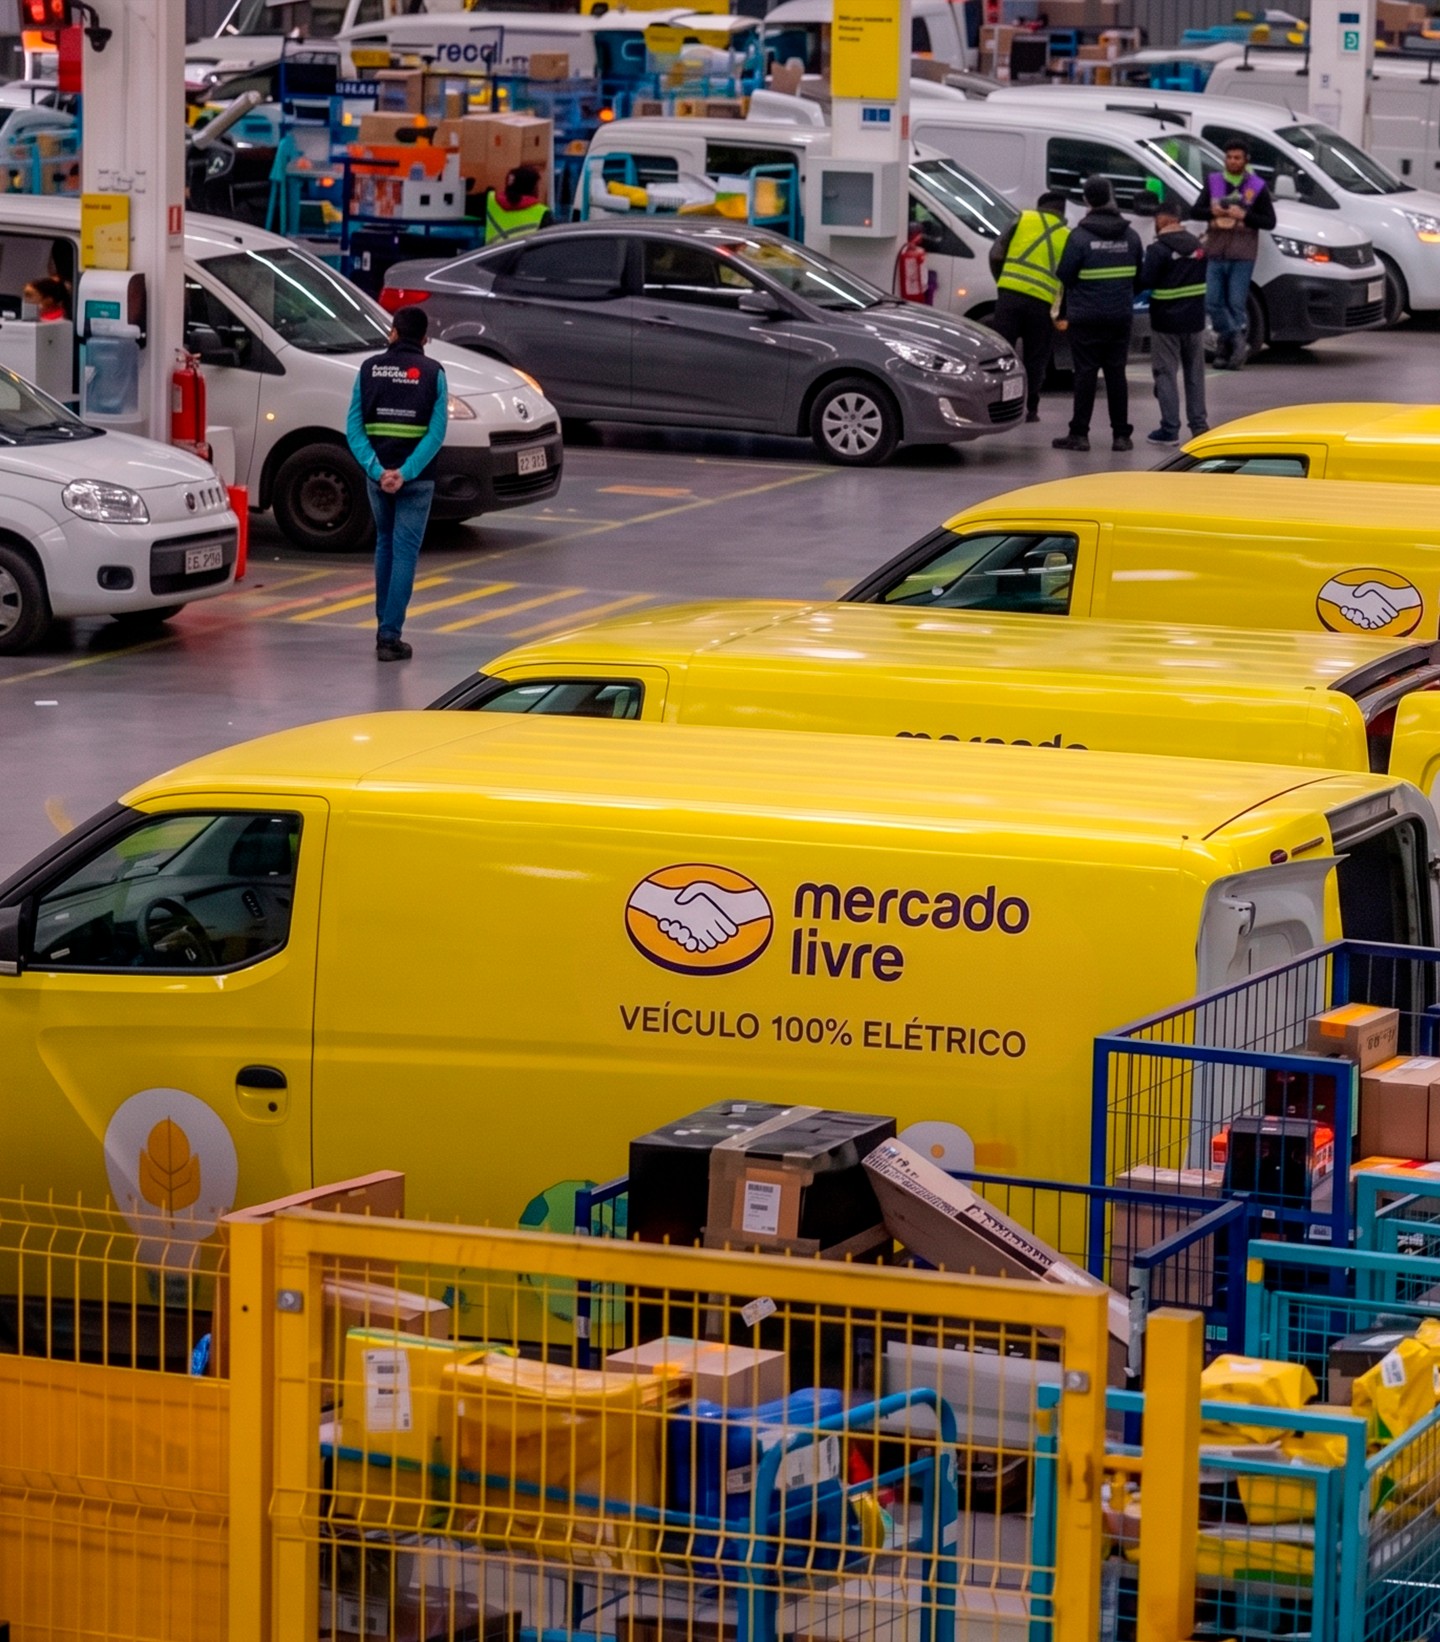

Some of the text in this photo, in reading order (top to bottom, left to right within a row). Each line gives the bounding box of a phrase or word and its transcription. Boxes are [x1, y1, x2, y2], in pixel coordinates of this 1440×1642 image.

[793, 882, 1030, 935] mercado
[790, 928, 905, 982] livre
[619, 1001, 1027, 1059] VEÍCULO 100% ELÉTRICO
